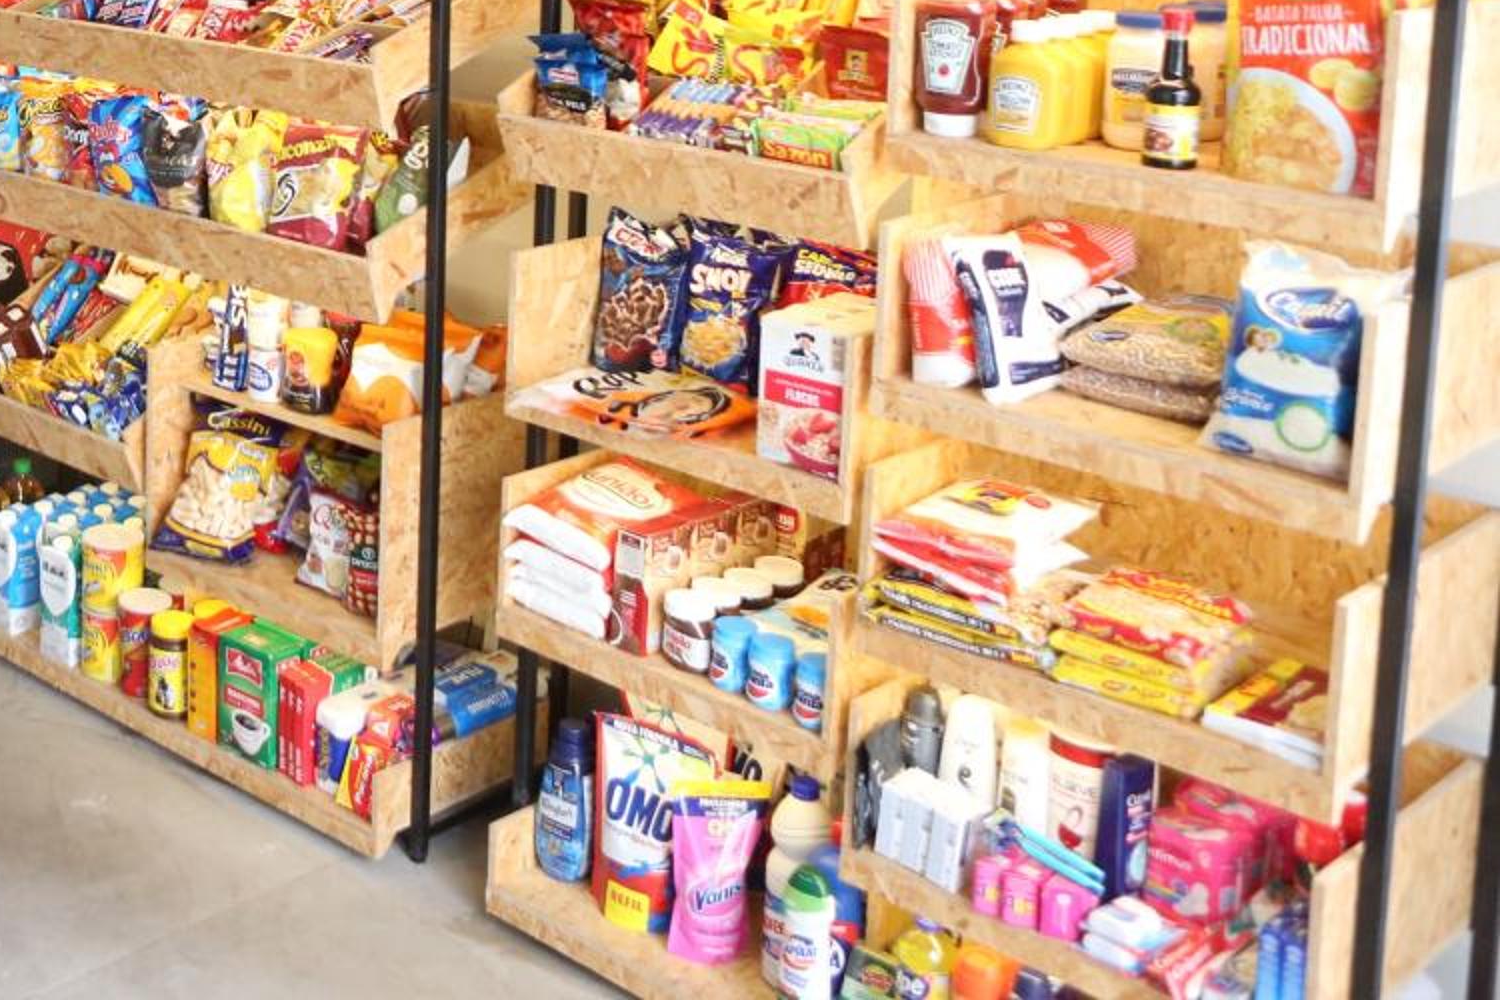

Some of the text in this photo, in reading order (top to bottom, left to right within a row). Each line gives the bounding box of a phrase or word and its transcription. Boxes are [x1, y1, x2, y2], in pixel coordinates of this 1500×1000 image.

[1242, 22, 1371, 56] TRADICIONAL
[207, 409, 272, 436] Cassini
[606, 777, 674, 842] OMO
[610, 889, 643, 911] REFIL
